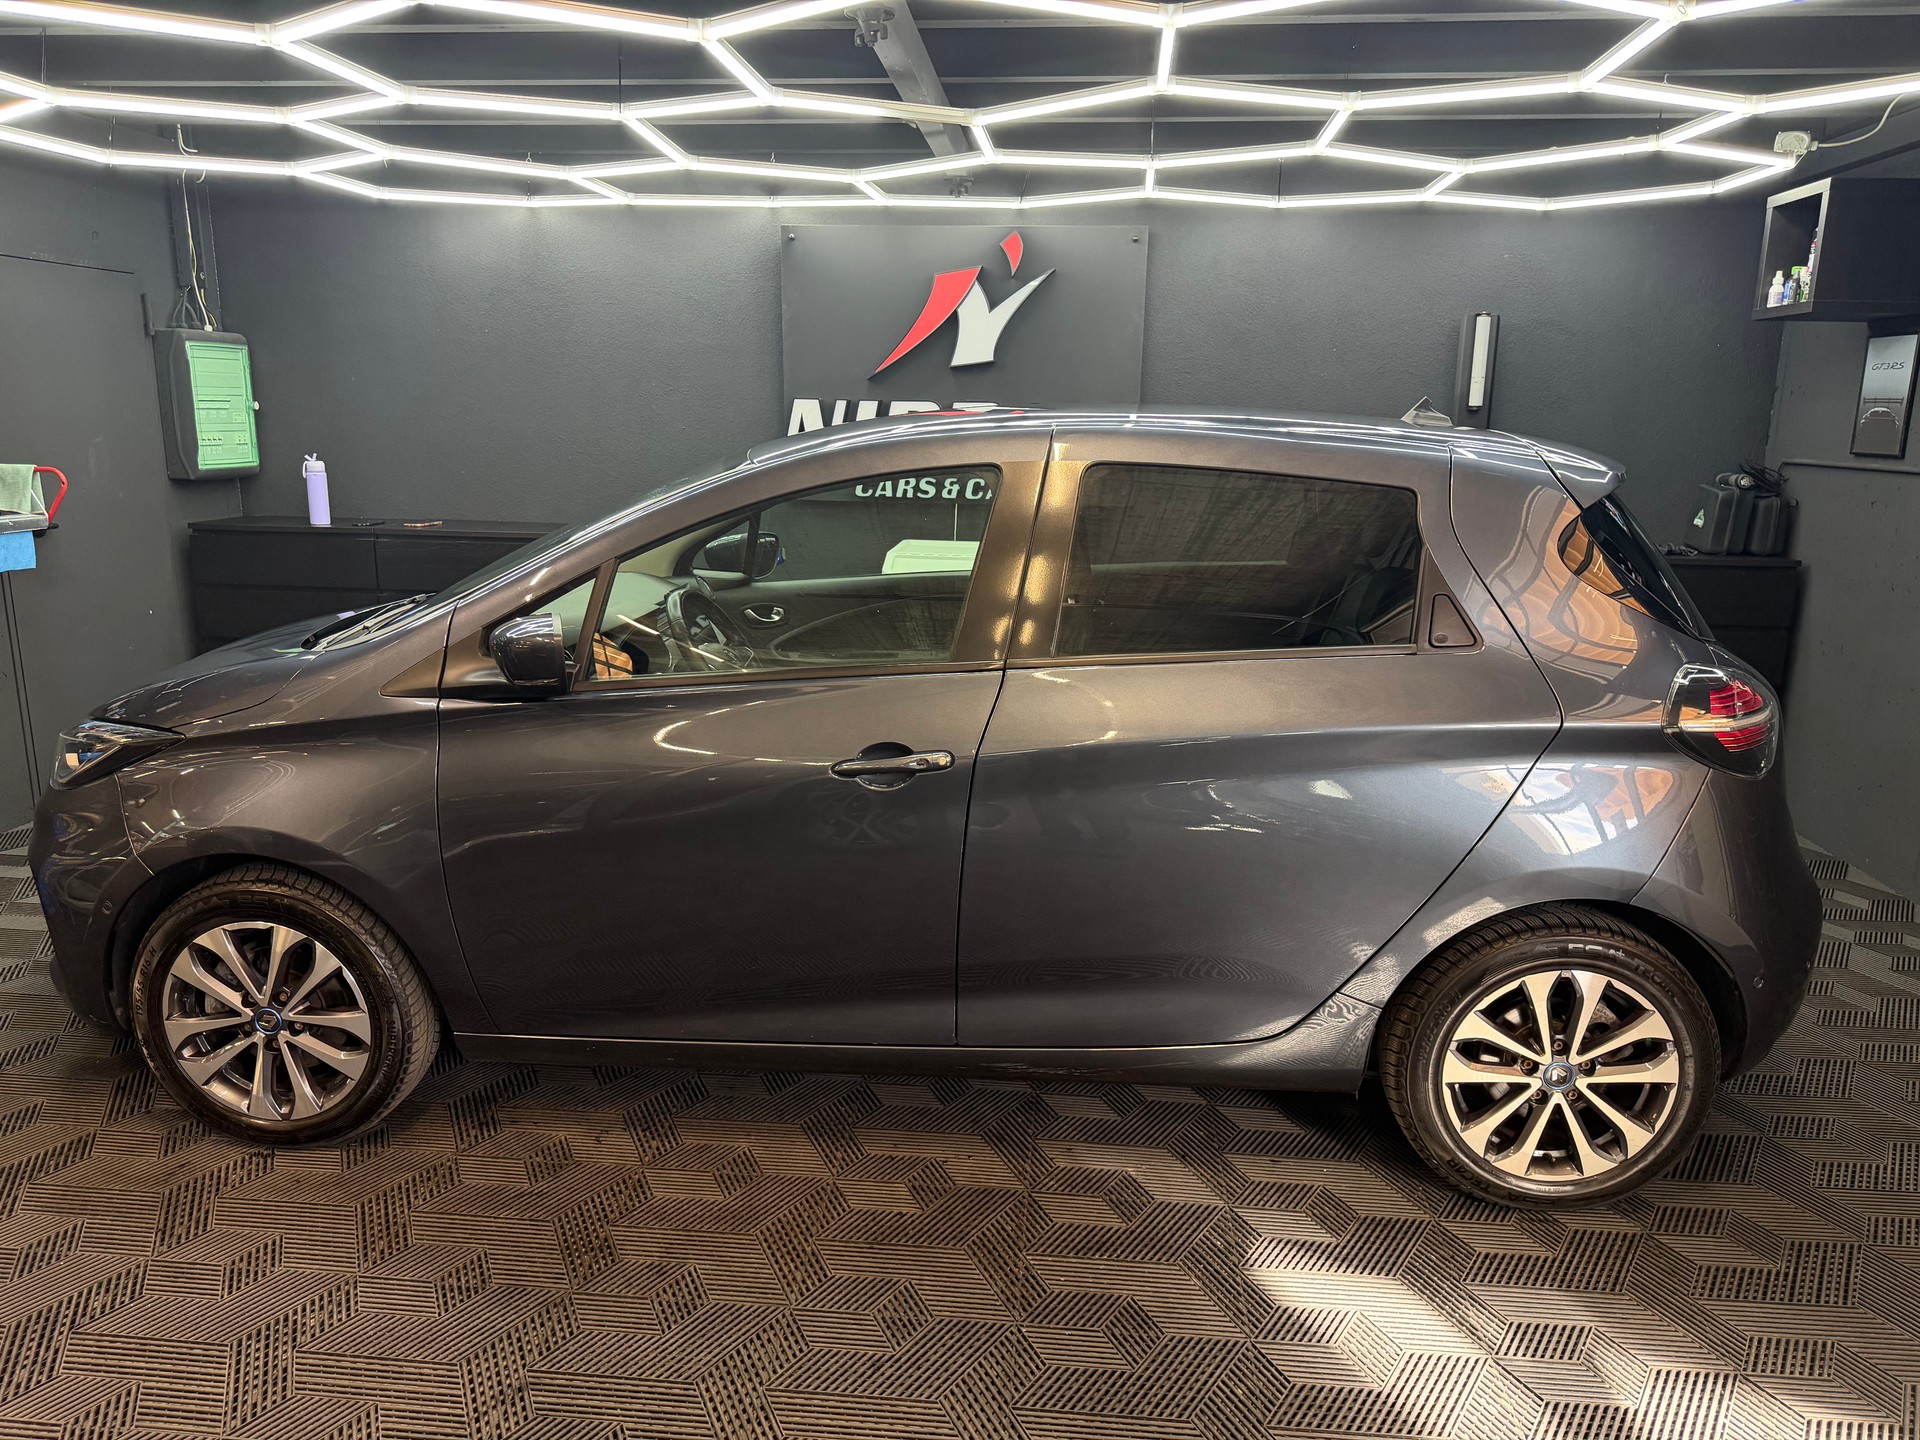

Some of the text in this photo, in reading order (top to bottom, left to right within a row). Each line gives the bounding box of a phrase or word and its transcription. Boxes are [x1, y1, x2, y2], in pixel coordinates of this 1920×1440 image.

[941, 478, 961, 500] &
[964, 478, 993, 500] C
[135, 945, 158, 1016] 195/55 R16 H
